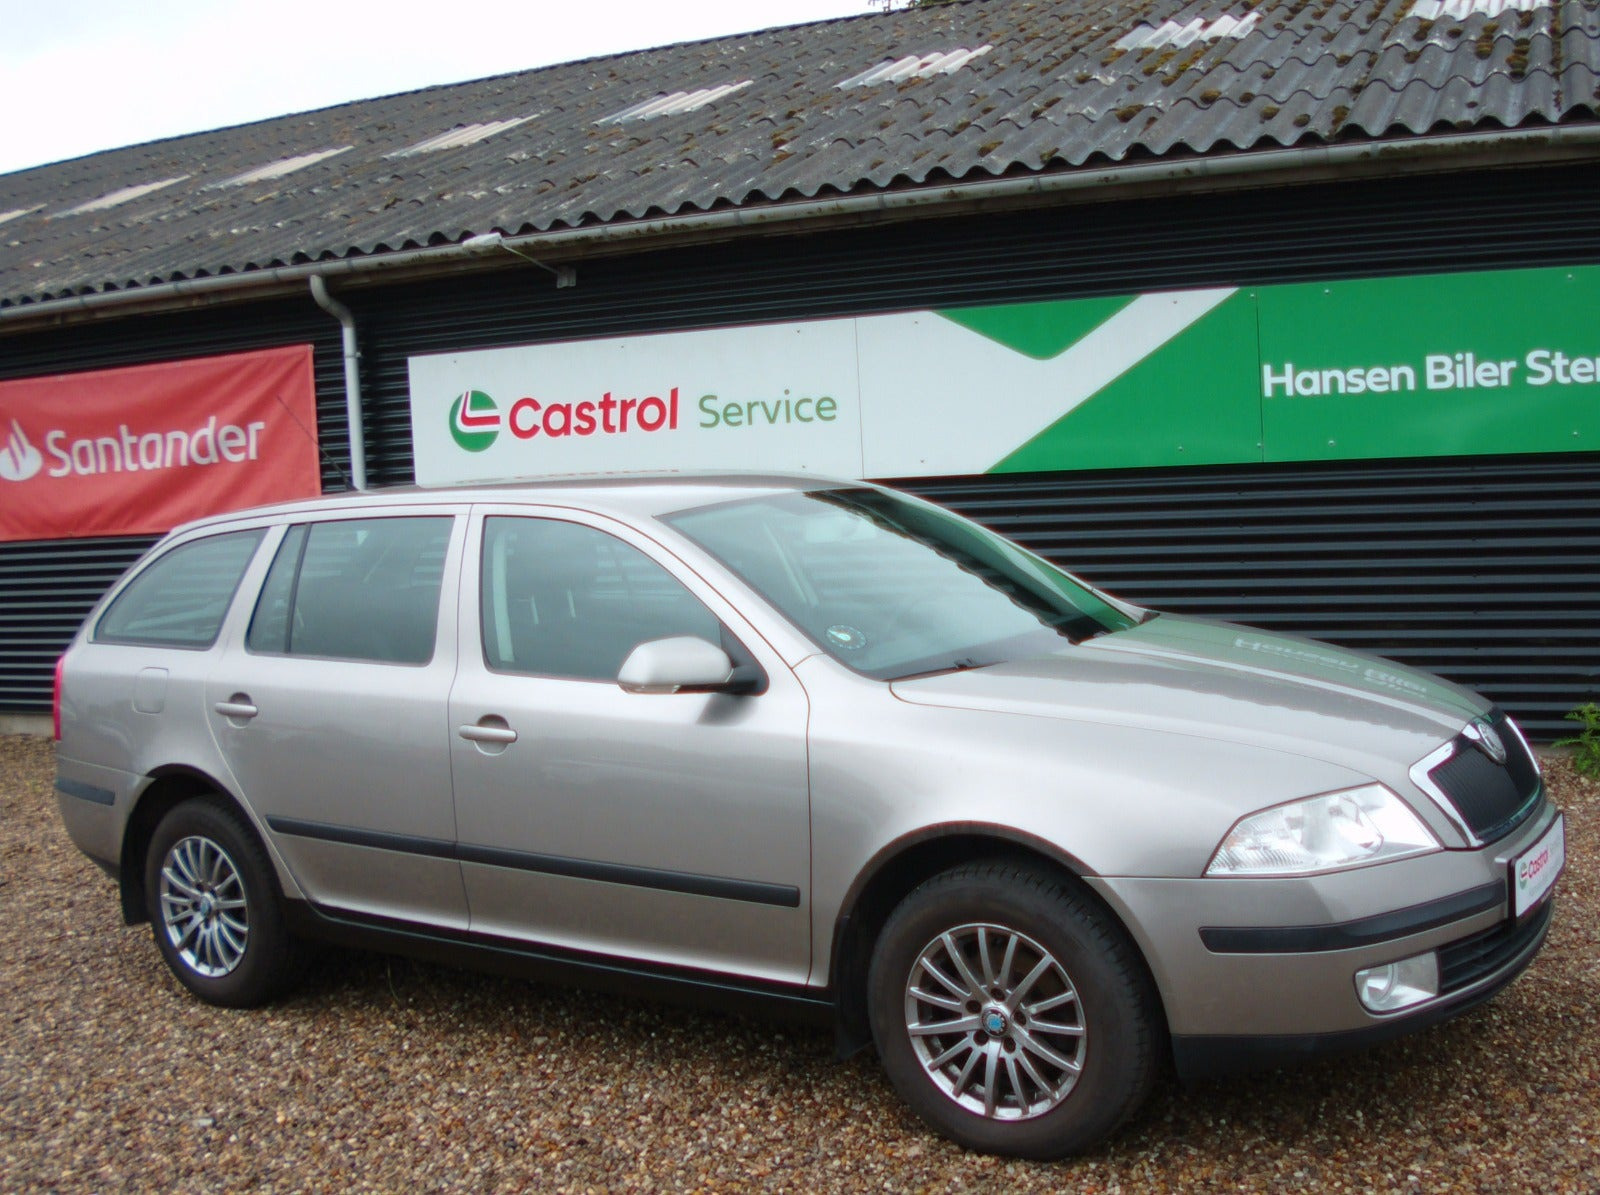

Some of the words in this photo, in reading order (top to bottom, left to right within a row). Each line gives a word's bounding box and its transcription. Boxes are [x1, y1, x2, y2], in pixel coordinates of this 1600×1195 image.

[1262, 363, 1416, 398] Hansen
[1425, 352, 1517, 390] Biler
[508, 386, 679, 440] Castrol
[698, 389, 837, 429] Service
[47, 415, 265, 478] Santander
